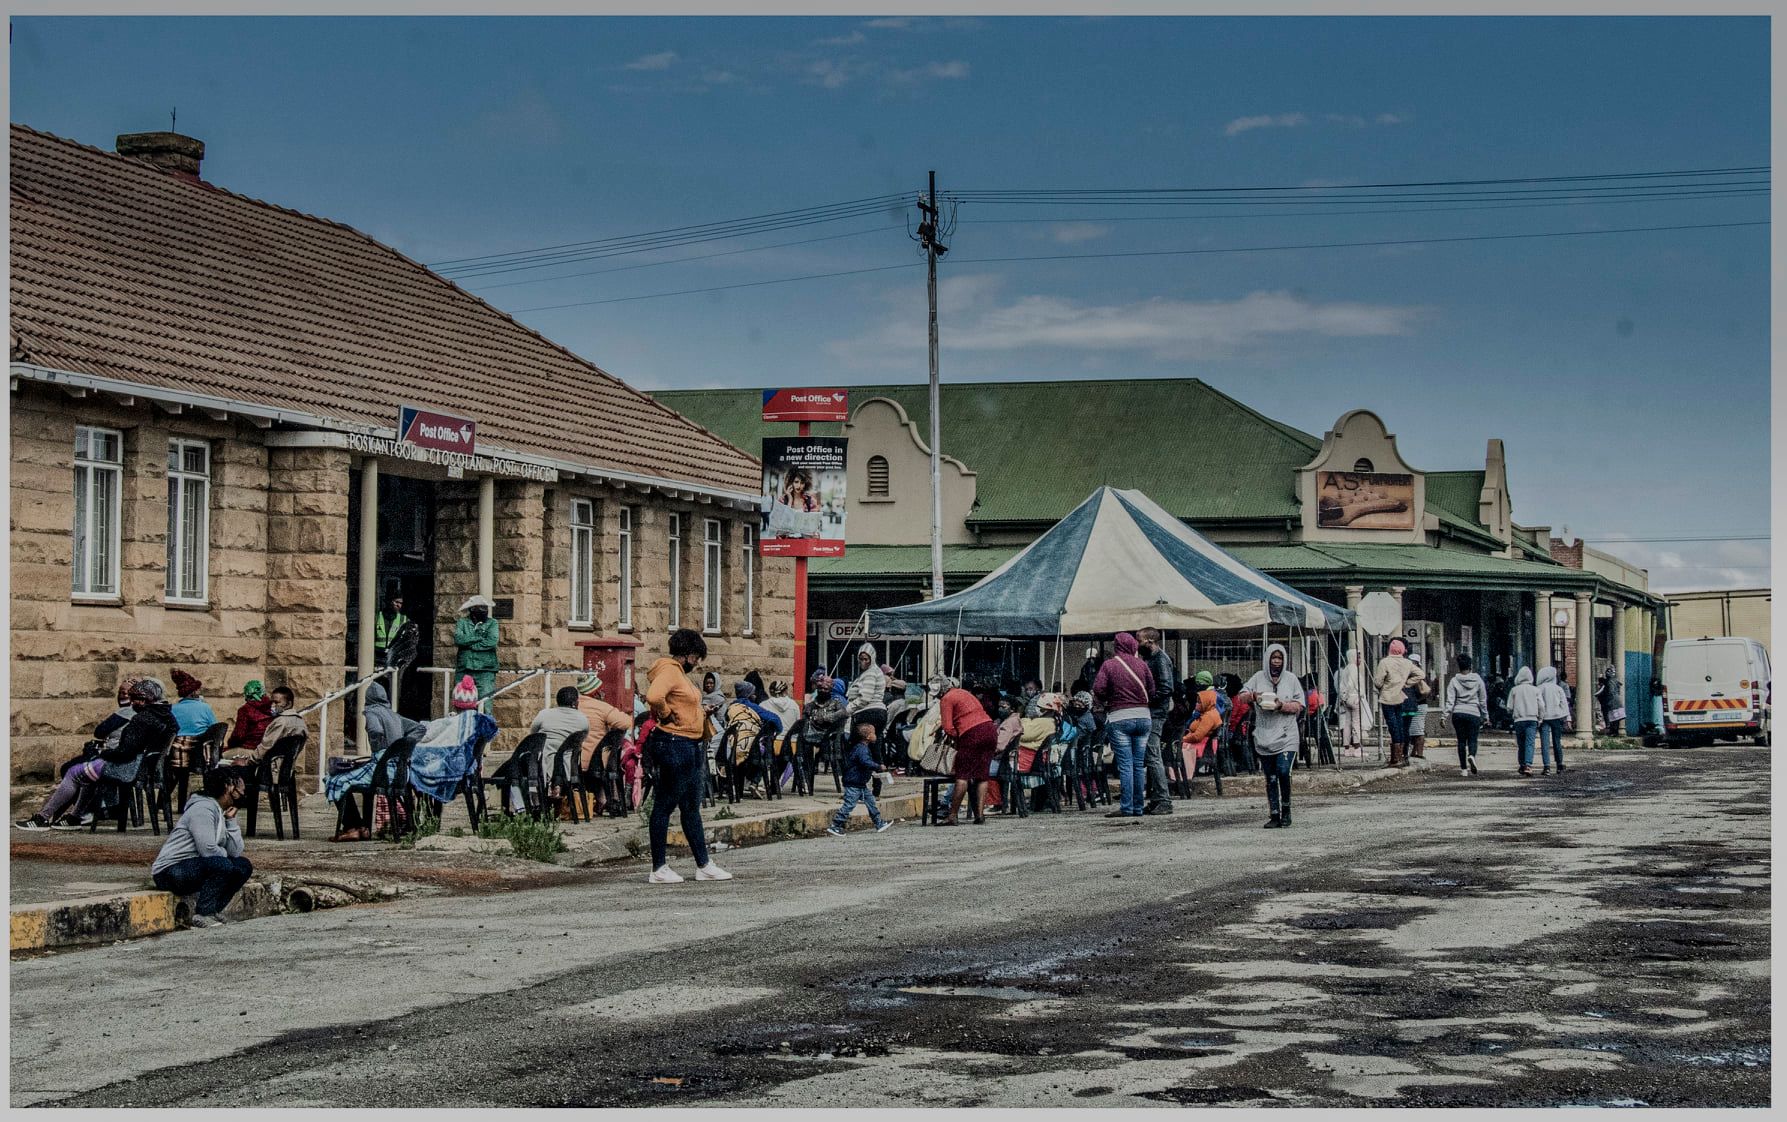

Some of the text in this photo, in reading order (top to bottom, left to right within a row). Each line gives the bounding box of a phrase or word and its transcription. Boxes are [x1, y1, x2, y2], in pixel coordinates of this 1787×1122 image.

[420, 423, 459, 443] Post Office
[429, 448, 482, 471] CLOCOLAN
[493, 457, 515, 476] POST
[804, 453, 843, 461] direction
